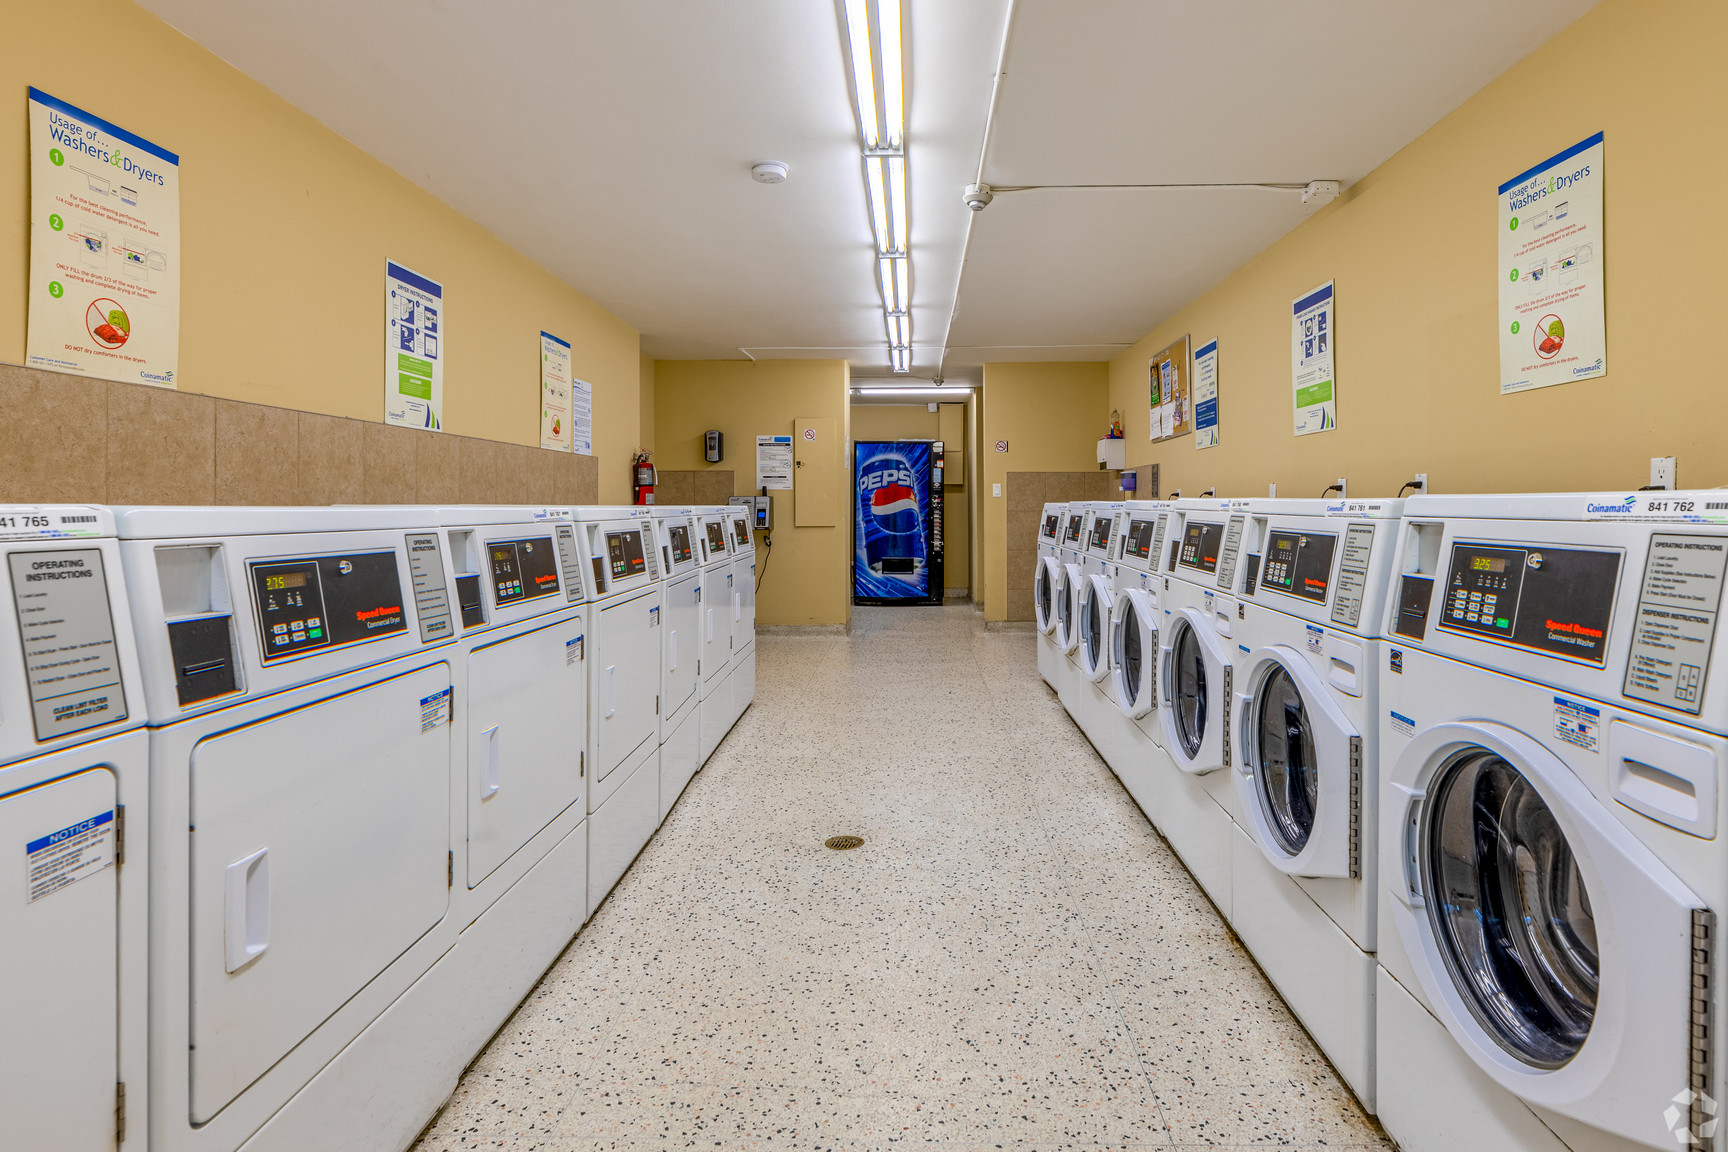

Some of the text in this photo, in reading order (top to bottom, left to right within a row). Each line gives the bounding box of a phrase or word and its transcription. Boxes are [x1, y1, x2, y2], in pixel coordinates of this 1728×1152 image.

[50, 112, 82, 135] Usage
[1510, 184, 1528, 200] Usage
[88, 200, 98, 208] best
[100, 204, 118, 216] cleaning
[118, 212, 148, 226] performance.
[106, 213, 128, 226] detergent
[148, 228, 160, 236] need.
[56, 262, 69, 271] ONLY
[70, 266, 80, 274] FILL
[142, 288, 158, 296] proper
[65, 272, 84, 283] washing
[94, 282, 116, 291] complete
[117, 286, 131, 296] drying
[398, 284, 434, 303] DRYER INSTRUCTIONS
[94, 350, 118, 359] comforters
[140, 370, 172, 382] Coinamatic
[1572, 365, 1600, 374] Coinamatic
[860, 470, 916, 494] PEPSI
[1587, 502, 1694, 512] Coinamatic 841 762
[22, 516, 49, 527] 765
[32, 560, 84, 570] OPERATING
[26, 570, 92, 582] INSTRUCTIONS
[356, 606, 400, 621] Speed Queen
[1642, 608, 1709, 624] DISPENSER INSTRUCTIONS
[367, 621, 390, 629] Commercial
[1546, 619, 1602, 638] Speed Queen
[1548, 632, 1596, 648] Commercial Washer
[53, 697, 108, 714] CLEAN LINT FILTER
[55, 704, 108, 721] AFTER EACH LOAD
[49, 819, 96, 844] NOTICE
